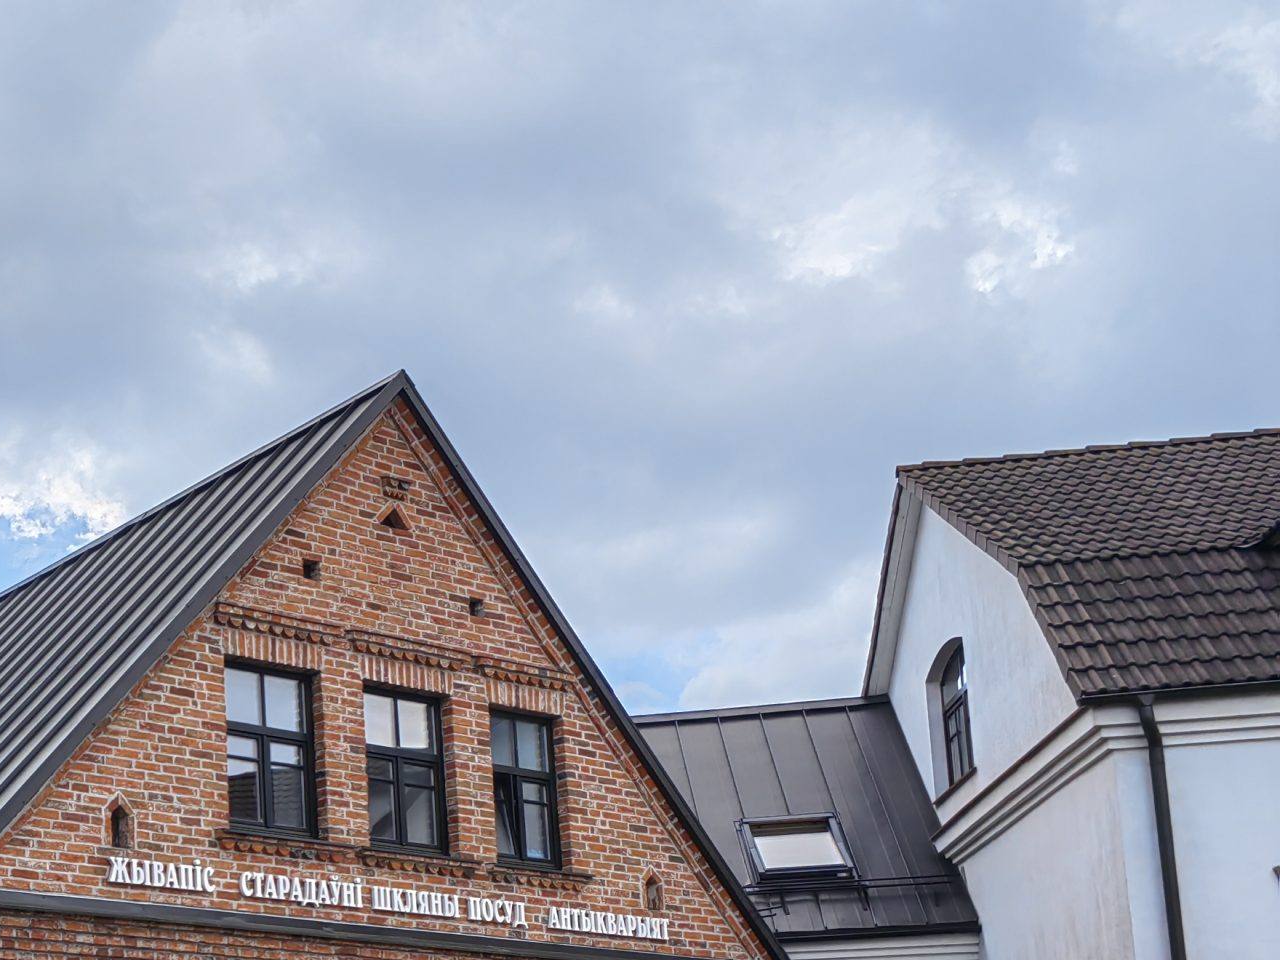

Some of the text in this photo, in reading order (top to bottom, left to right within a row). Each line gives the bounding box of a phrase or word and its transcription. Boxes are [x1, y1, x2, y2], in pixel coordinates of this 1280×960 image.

[108, 856, 670, 940] ЖЫВАПІС СТАРАДАЎНІ ШКЛЯНЫ ПОСУД АНТЫКВАРЫЯТ
